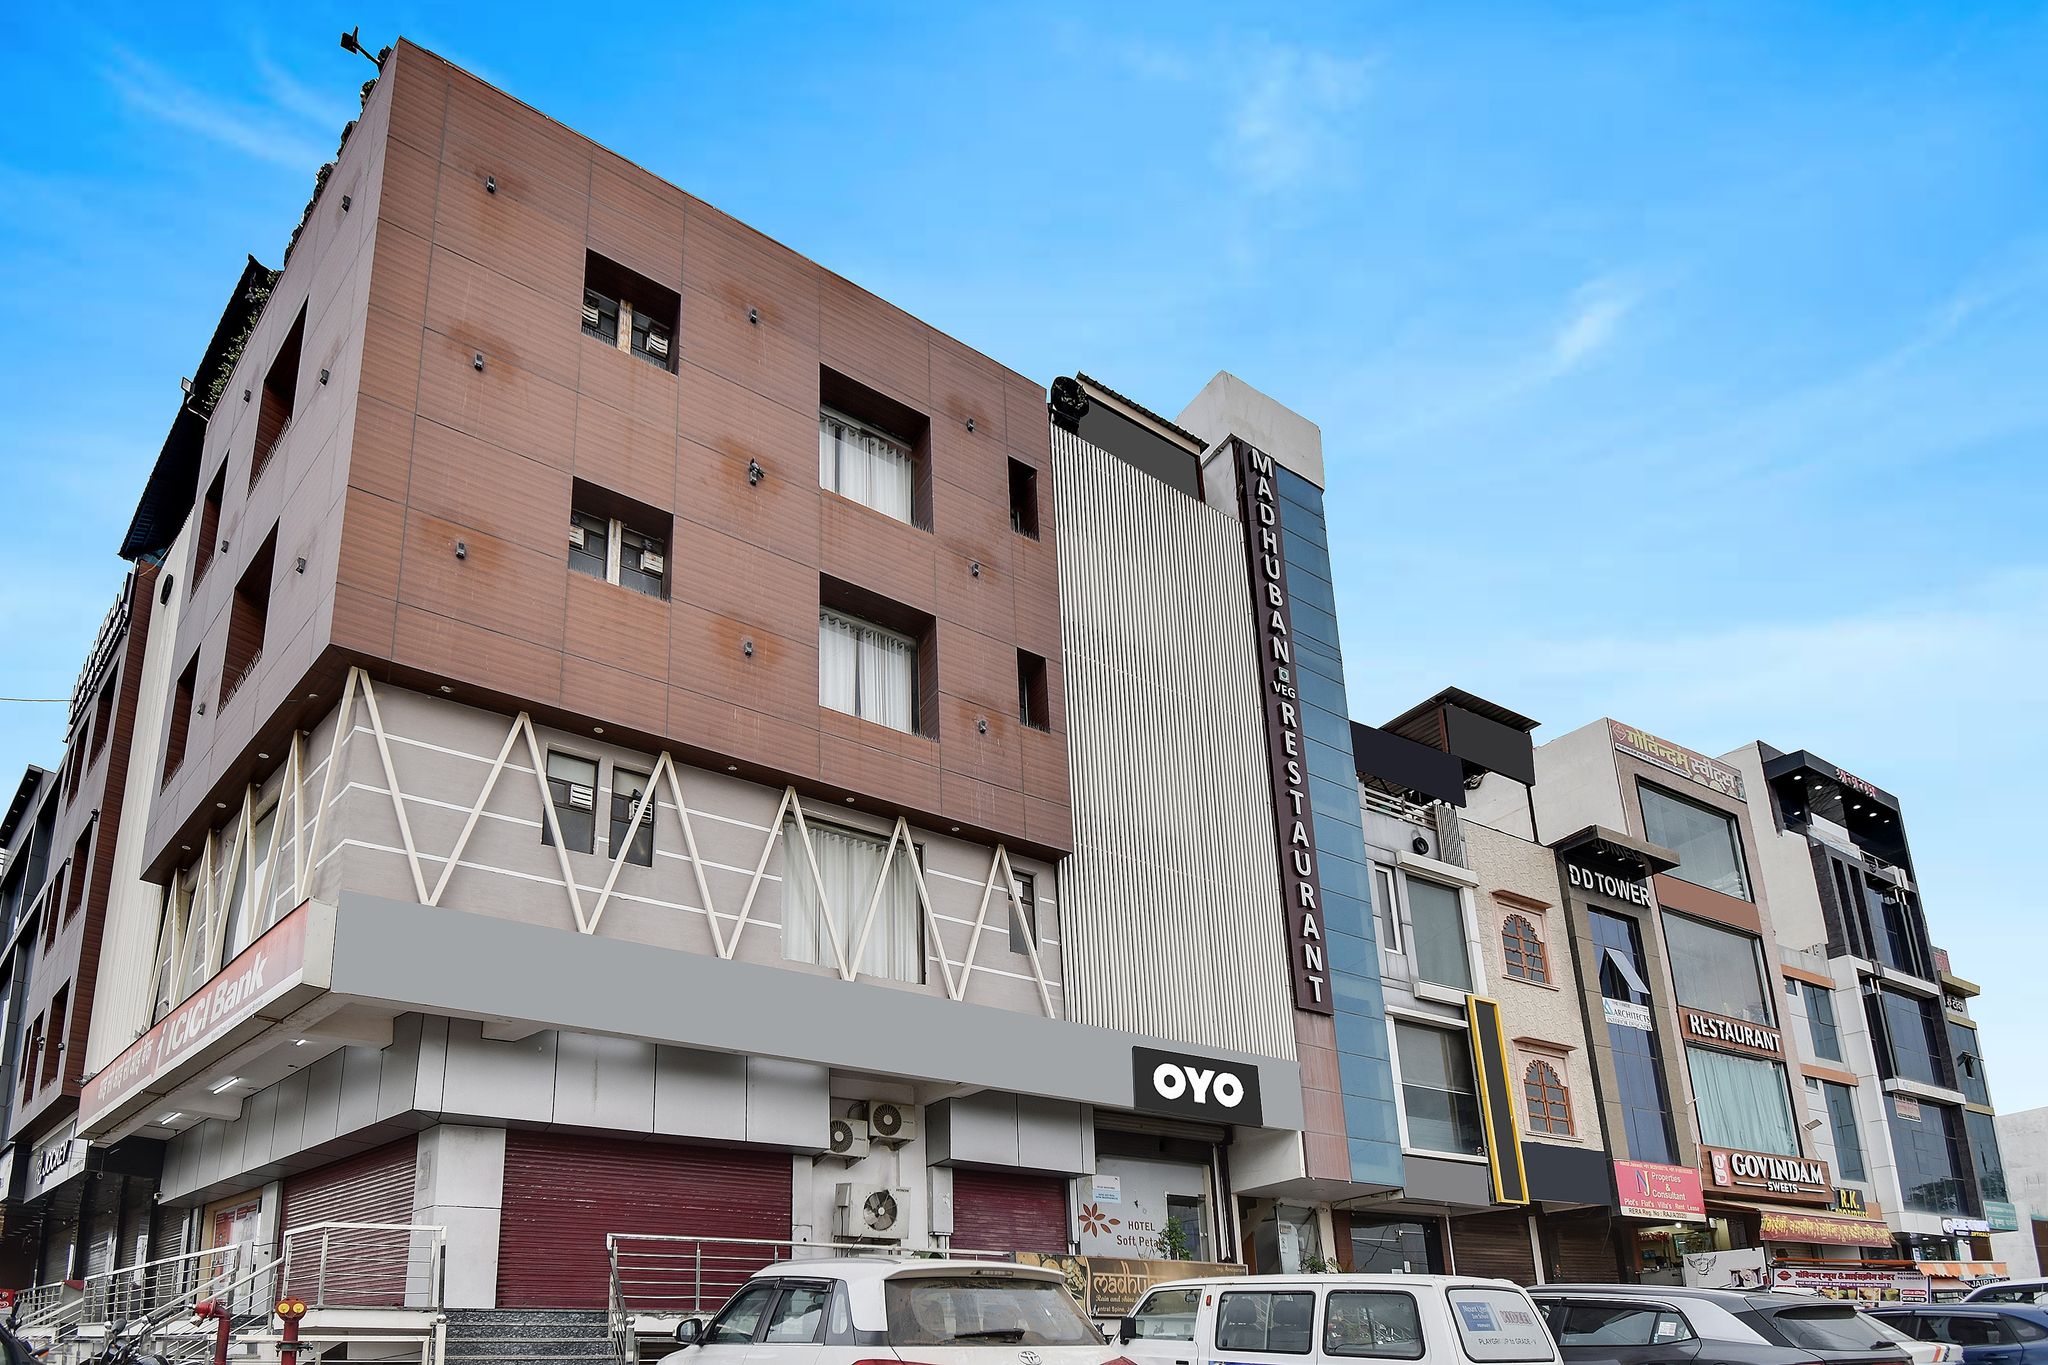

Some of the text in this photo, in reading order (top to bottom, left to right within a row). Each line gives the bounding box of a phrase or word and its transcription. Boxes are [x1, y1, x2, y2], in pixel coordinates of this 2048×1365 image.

[1251, 448, 1290, 664] MADHUBAN
[1273, 680, 1296, 699] VEG
[1281, 700, 1324, 1003] RESTAURANT
[1594, 872, 1652, 908] TOWER
[166, 991, 213, 1057] ICICI
[210, 952, 268, 1024] Bank
[1614, 1009, 1650, 1024] ARCHITECTS
[1689, 1013, 1781, 1053] RESTAURANT
[1153, 1063, 1245, 1108] OYO
[1651, 1171, 1681, 1183] Properties
[1731, 1153, 1826, 1185] GOVINDAM
[1652, 1189, 1686, 1201] Consultant
[1665, 1183, 1671, 1192] &
[1767, 1182, 1799, 1194] SWEETS
[1840, 1188, 1860, 1209] R.K.
[1127, 1220, 1156, 1232] HOTEL
[1116, 1235, 1137, 1247] Soft
